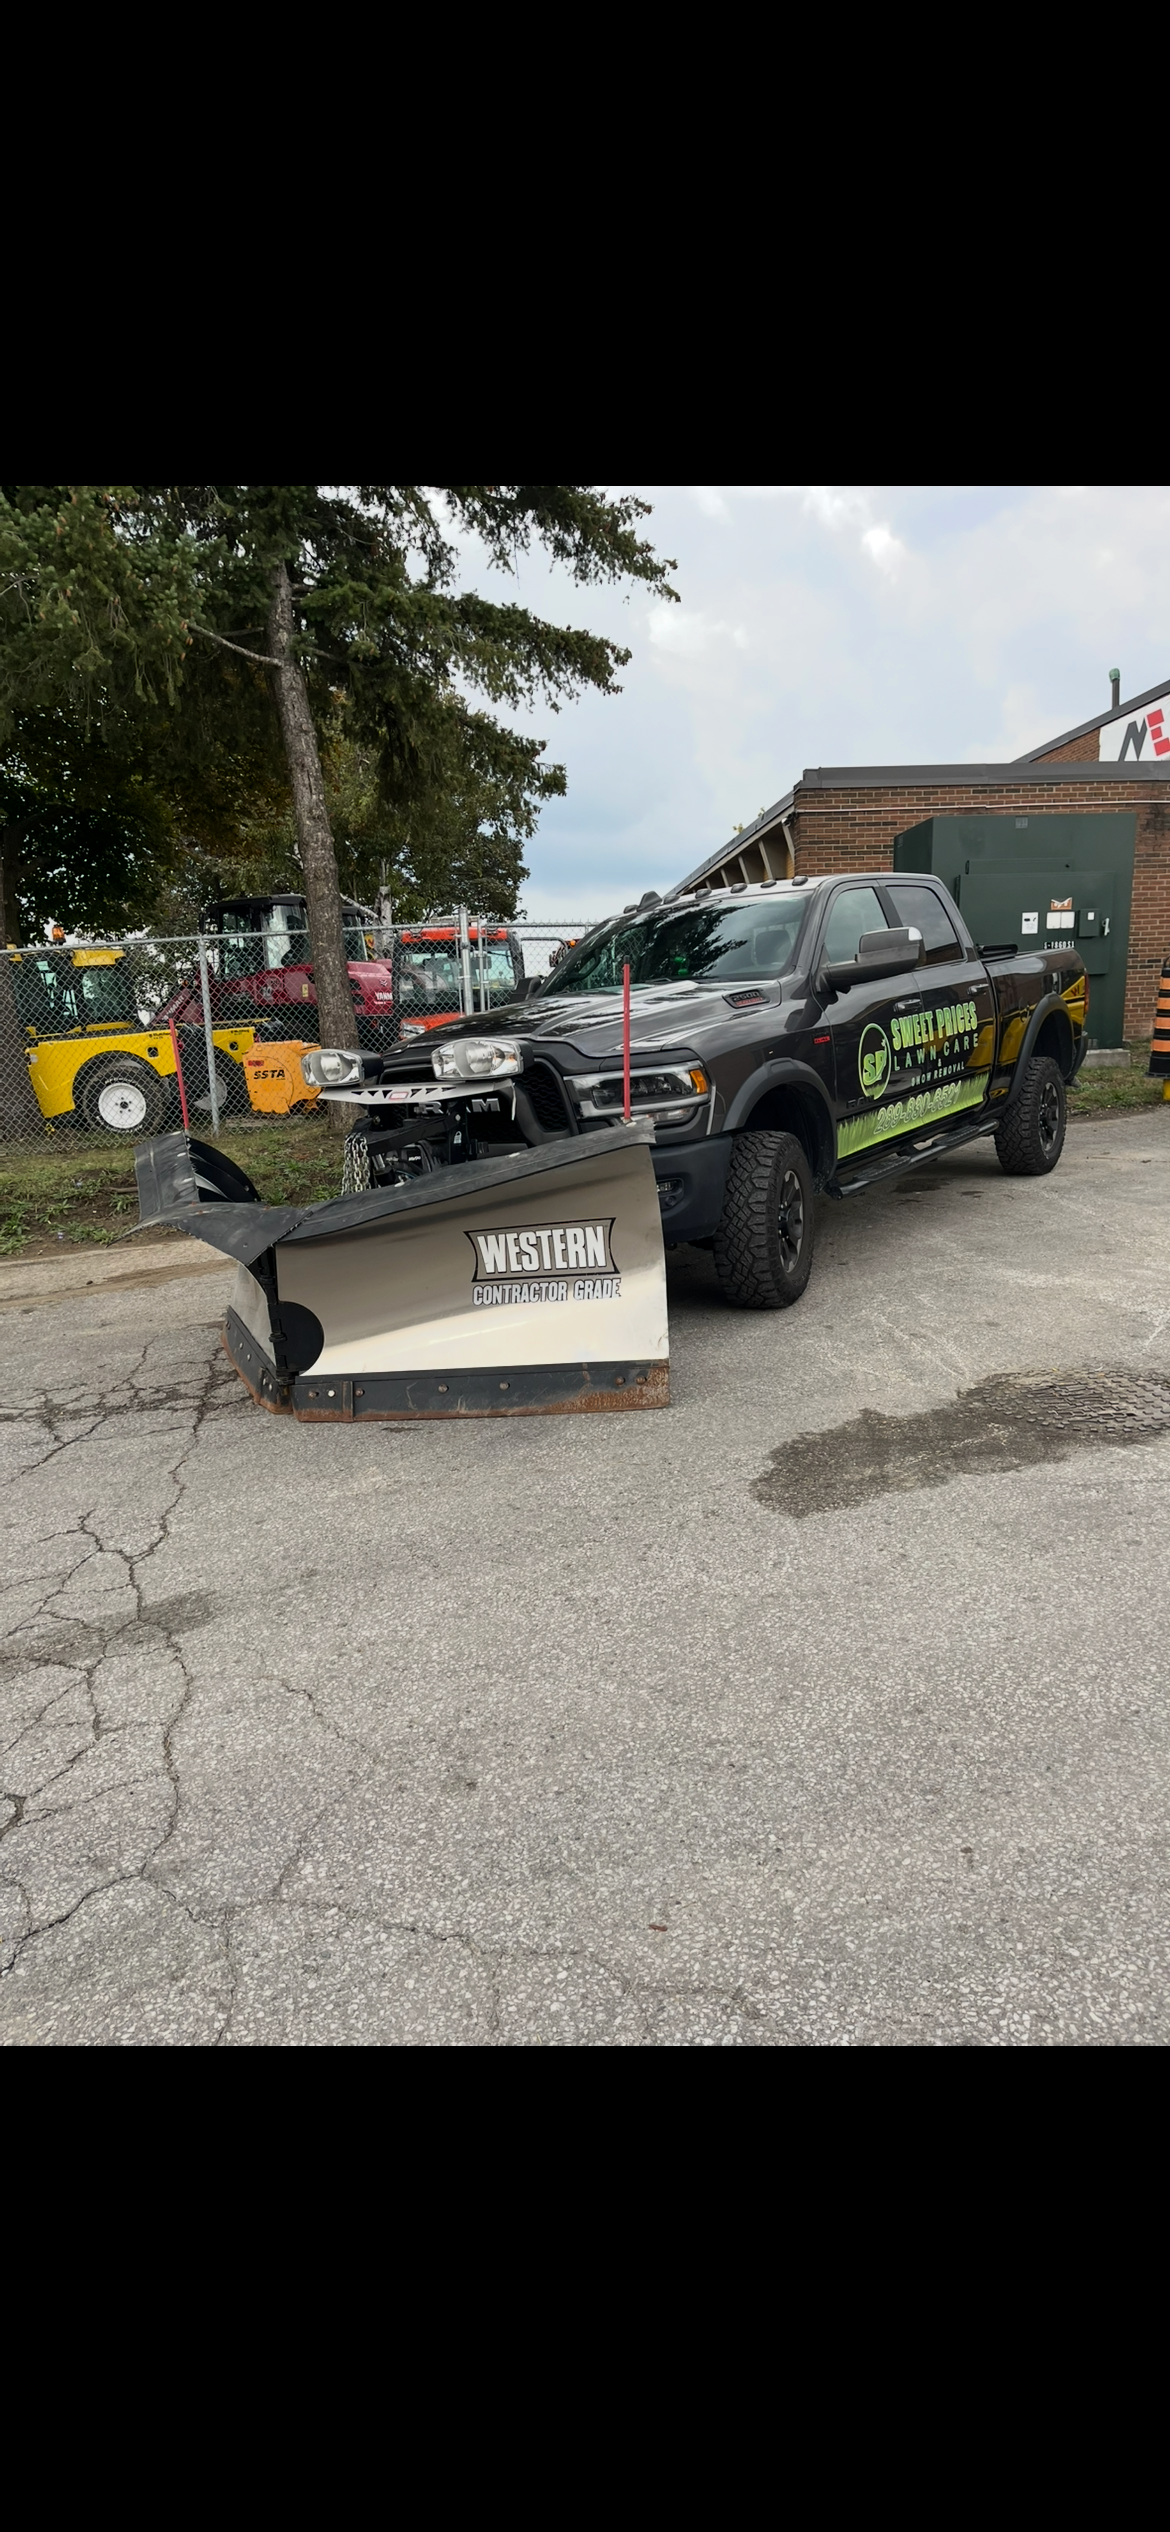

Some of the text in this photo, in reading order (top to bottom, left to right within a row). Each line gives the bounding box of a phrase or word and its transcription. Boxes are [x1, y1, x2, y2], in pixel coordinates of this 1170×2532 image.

[890, 1001, 978, 1051] SWEET PRICES
[894, 1033, 979, 1072] LAWN CARE
[253, 1069, 286, 1080] SSTA
[911, 1061, 965, 1087] SNOW REMOVAL
[417, 1098, 501, 1115] RM
[477, 1225, 607, 1275] WESTERN
[473, 1278, 622, 1306] CONTRACTOR GRADE
